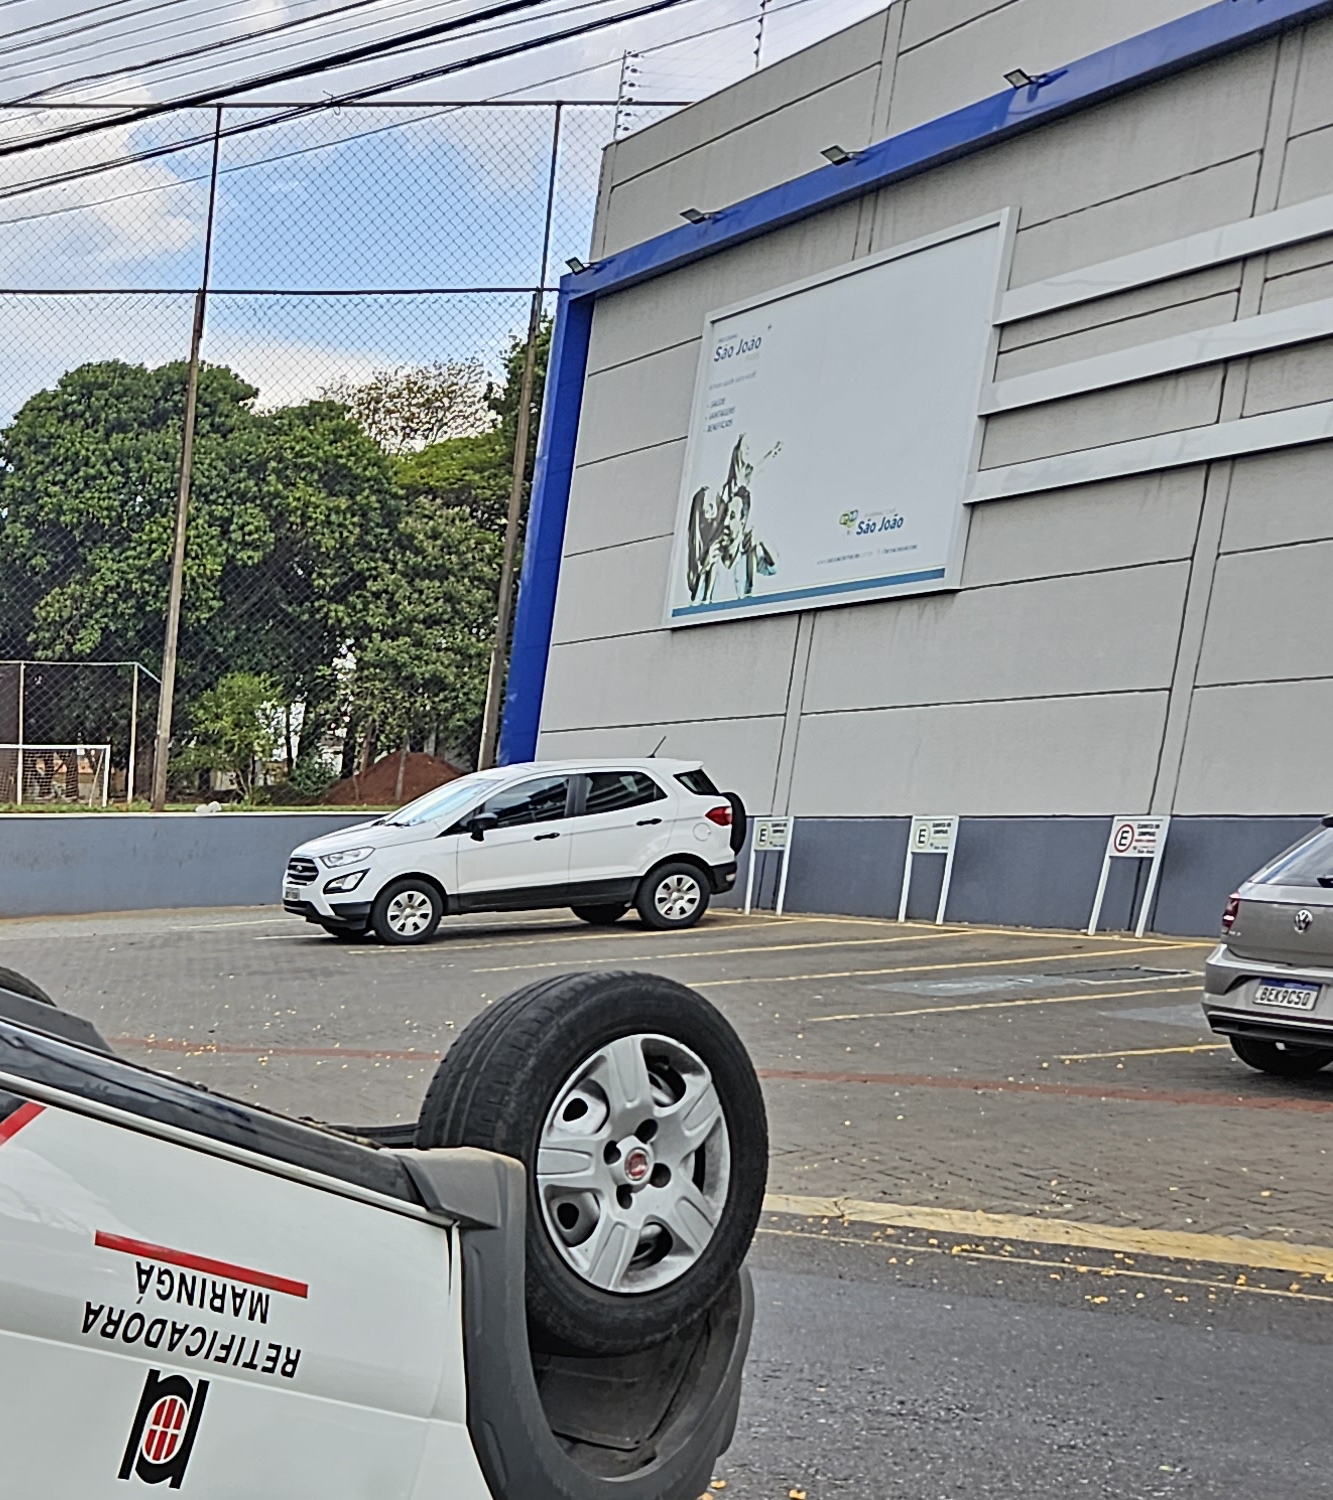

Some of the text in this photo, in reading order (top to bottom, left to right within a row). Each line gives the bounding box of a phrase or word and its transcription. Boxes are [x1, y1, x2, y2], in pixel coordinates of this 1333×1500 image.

[714, 344, 734, 362] São
[736, 335, 762, 356] João
[856, 514, 904, 535] São João
[918, 829, 926, 844] E
[1118, 830, 1130, 846] E
[136, 1260, 270, 1324] MARINGÁ
[82, 1301, 302, 1379] RETIFICADORA
